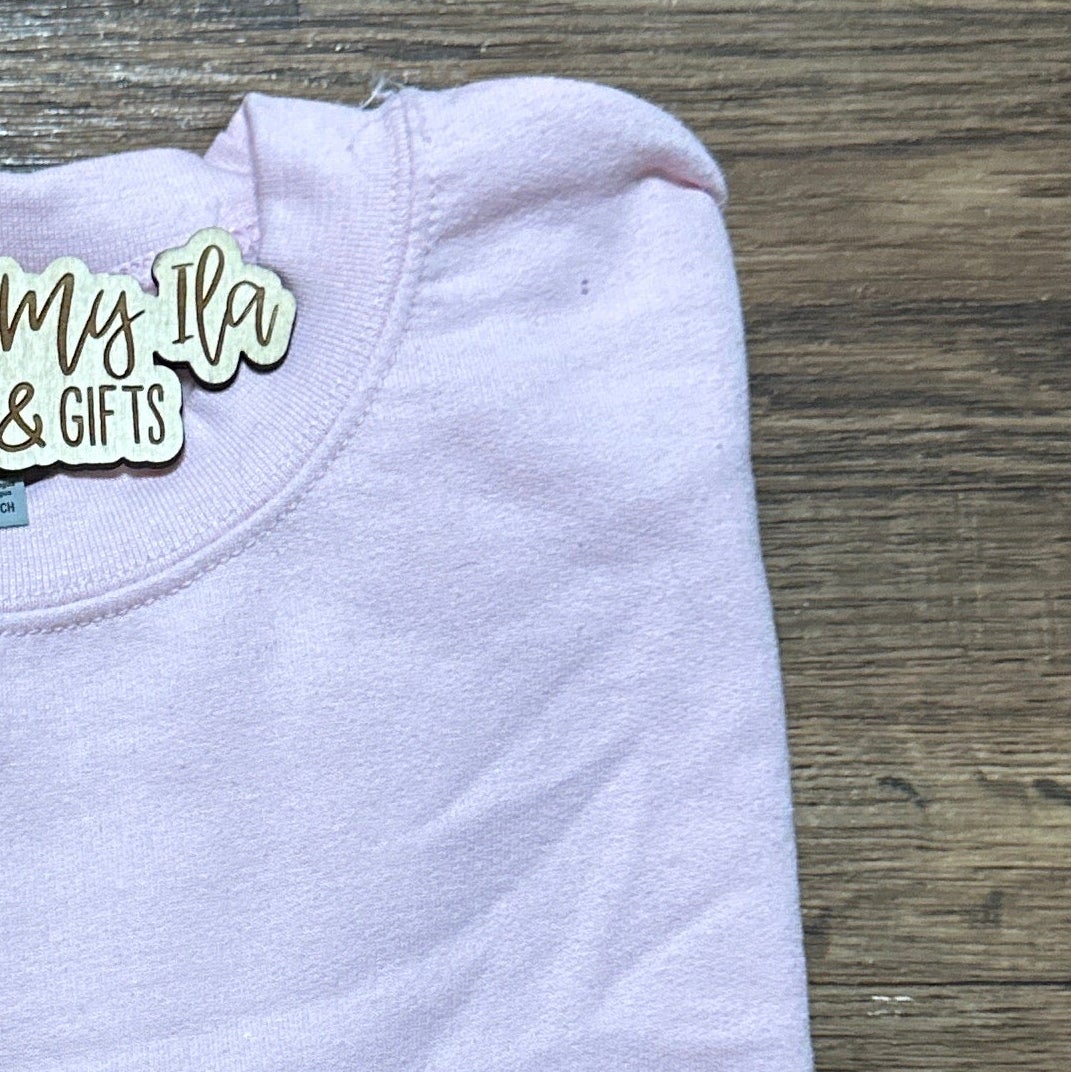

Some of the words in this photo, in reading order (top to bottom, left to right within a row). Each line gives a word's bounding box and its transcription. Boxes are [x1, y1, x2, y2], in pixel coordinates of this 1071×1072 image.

[171, 245, 281, 366] Ila
[59, 382, 166, 448] GIFTS
[0, 501, 15, 514] CH
